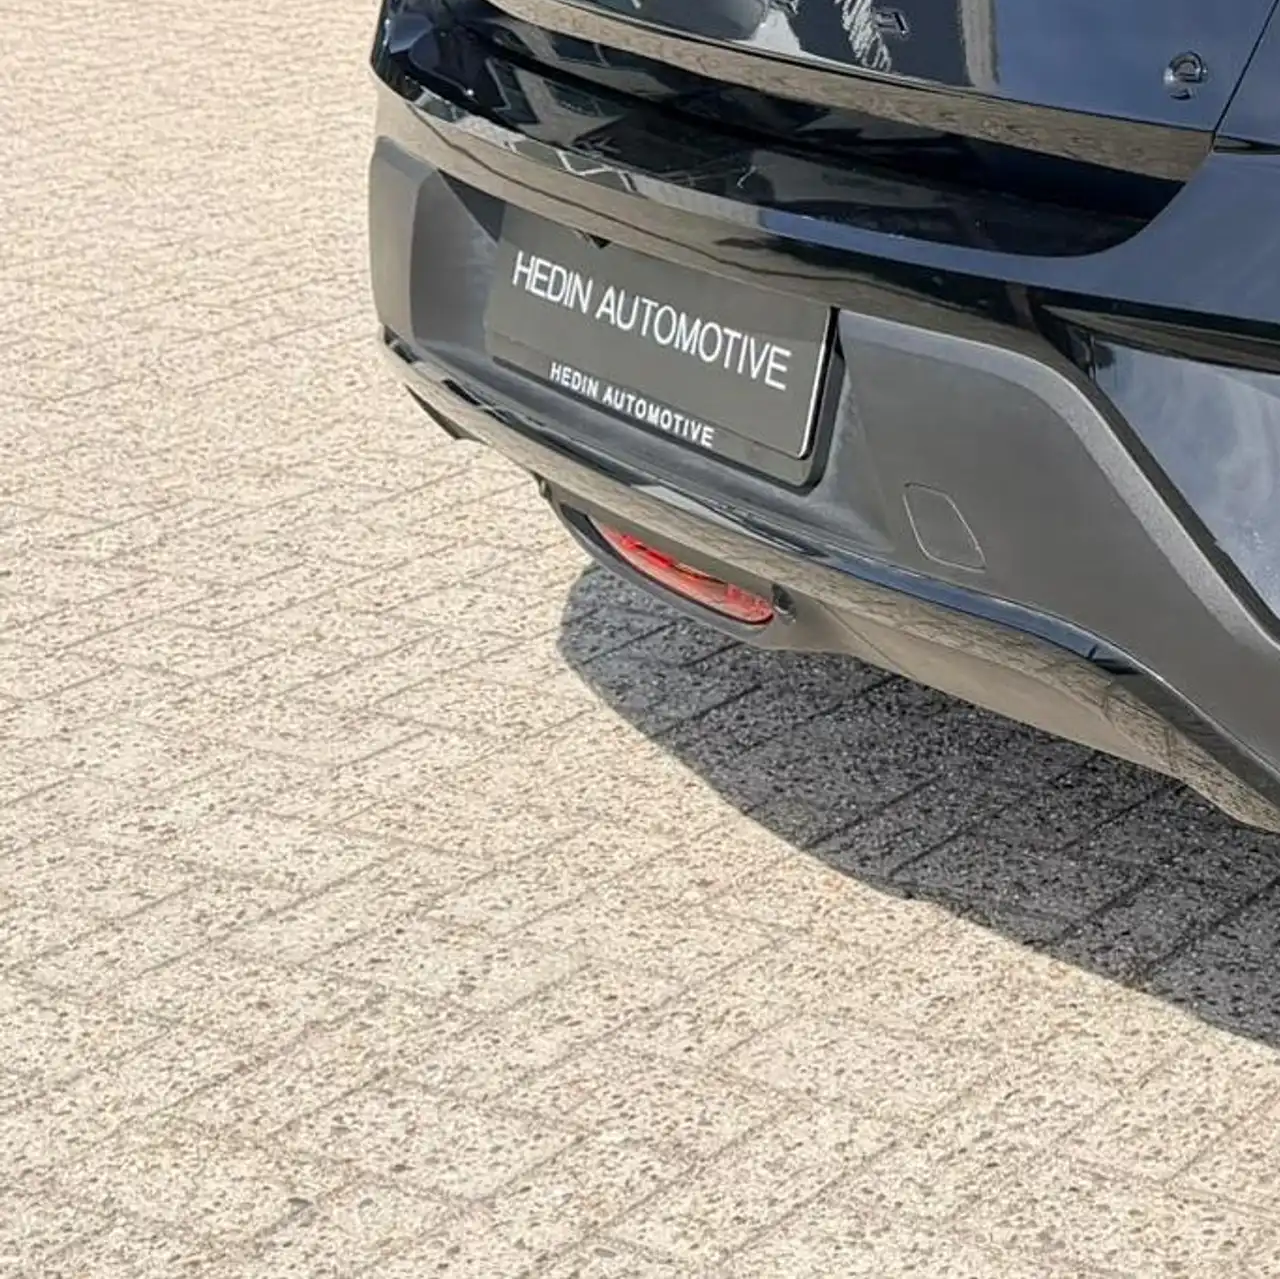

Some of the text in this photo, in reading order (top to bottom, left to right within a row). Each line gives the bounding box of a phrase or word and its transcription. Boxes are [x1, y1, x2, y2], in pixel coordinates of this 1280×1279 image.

[512, 250, 792, 392] HEDIN AUTOMOTIVE
[550, 361, 715, 448] HEDIN AUTOMOTIVE
